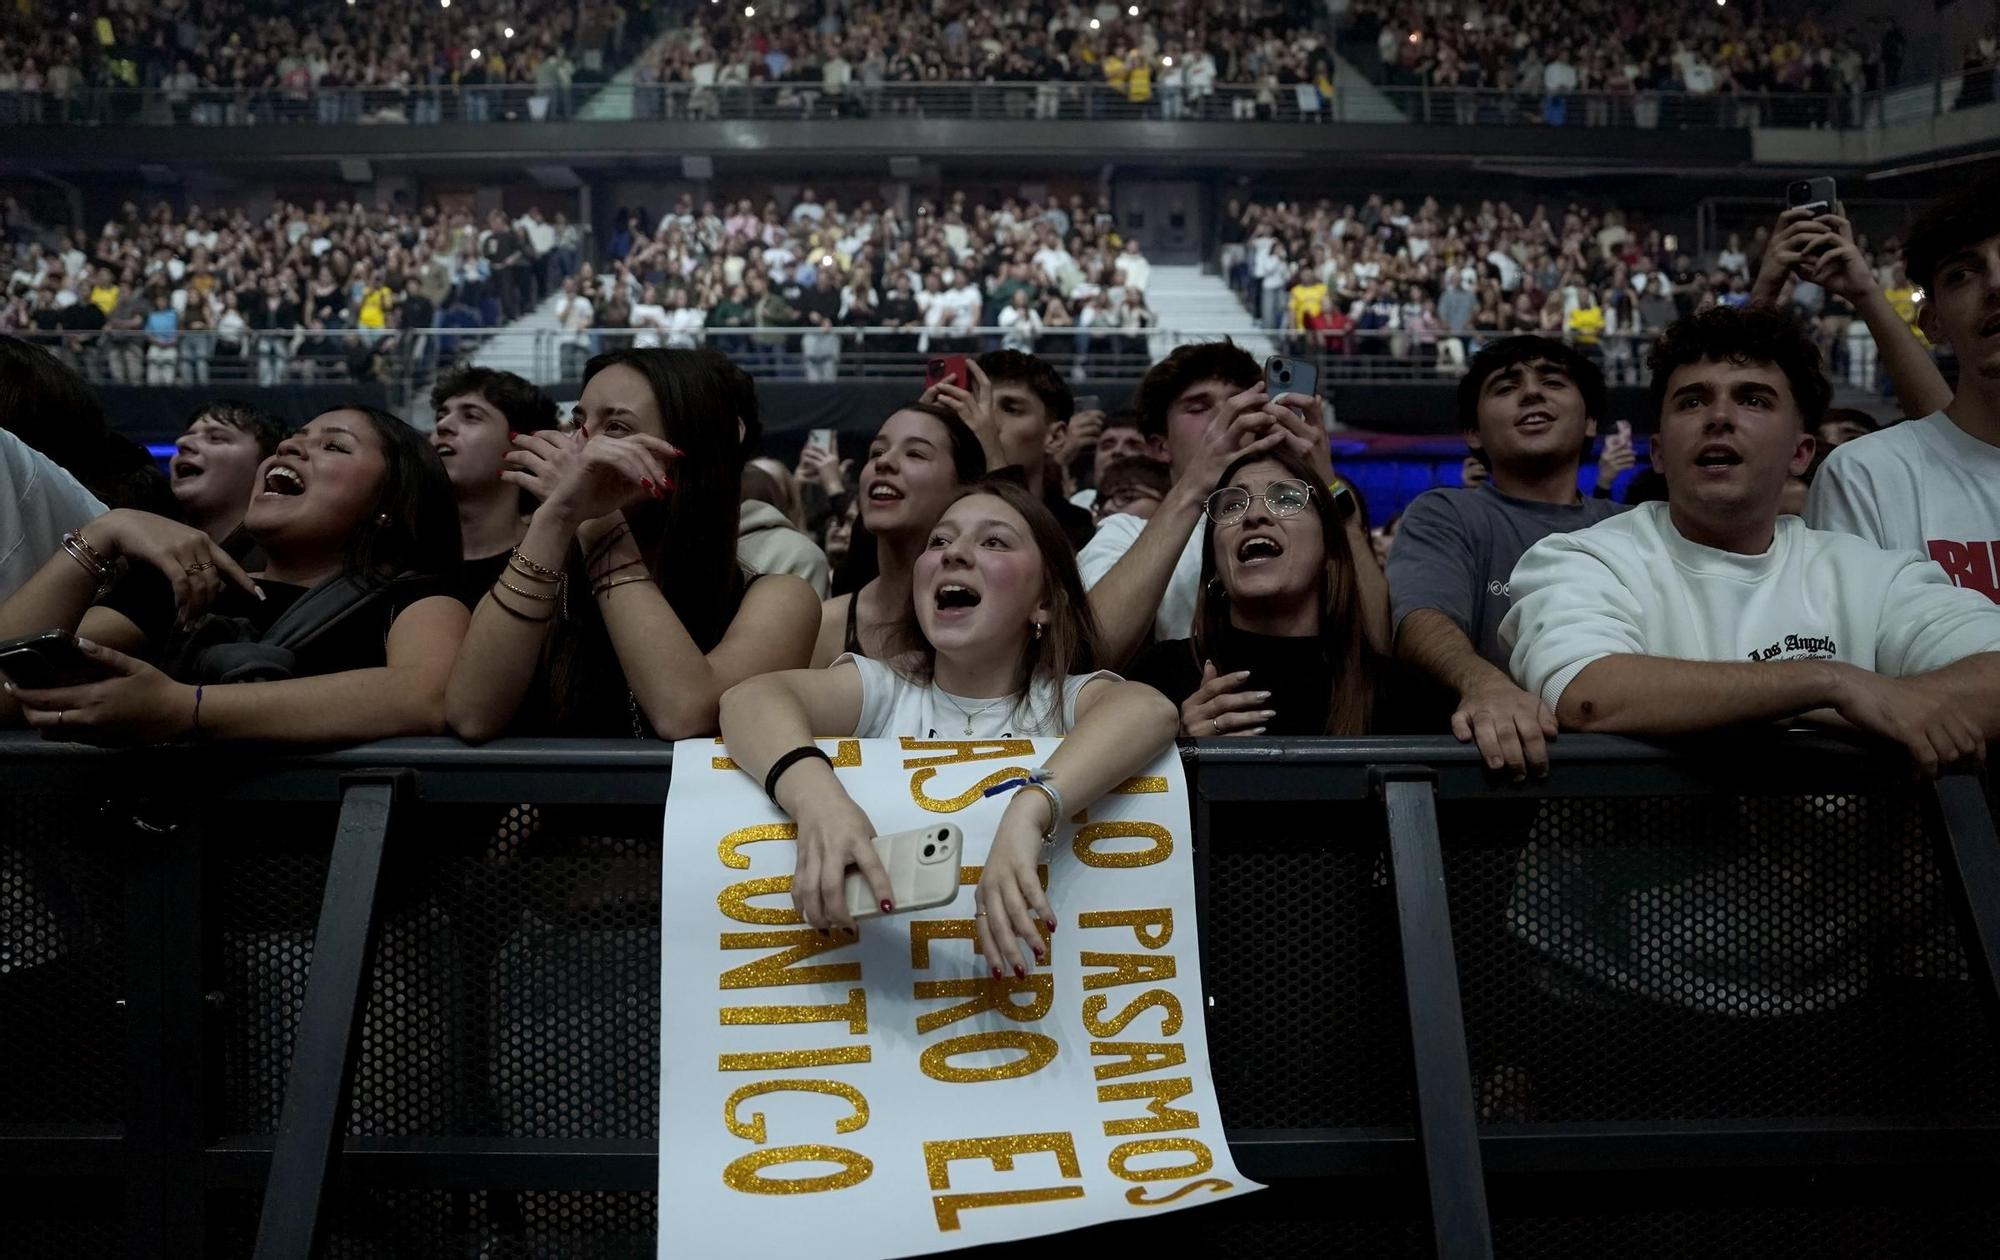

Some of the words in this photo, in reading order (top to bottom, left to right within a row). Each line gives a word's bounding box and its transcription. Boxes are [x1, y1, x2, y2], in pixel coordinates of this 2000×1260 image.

[1748, 642, 1782, 661] Los
[717, 823, 874, 1195] CONTIGO
[909, 864, 1059, 1083] ERO
[1078, 907, 1234, 1206] PASAMOS
[923, 1131, 1085, 1232] EL
